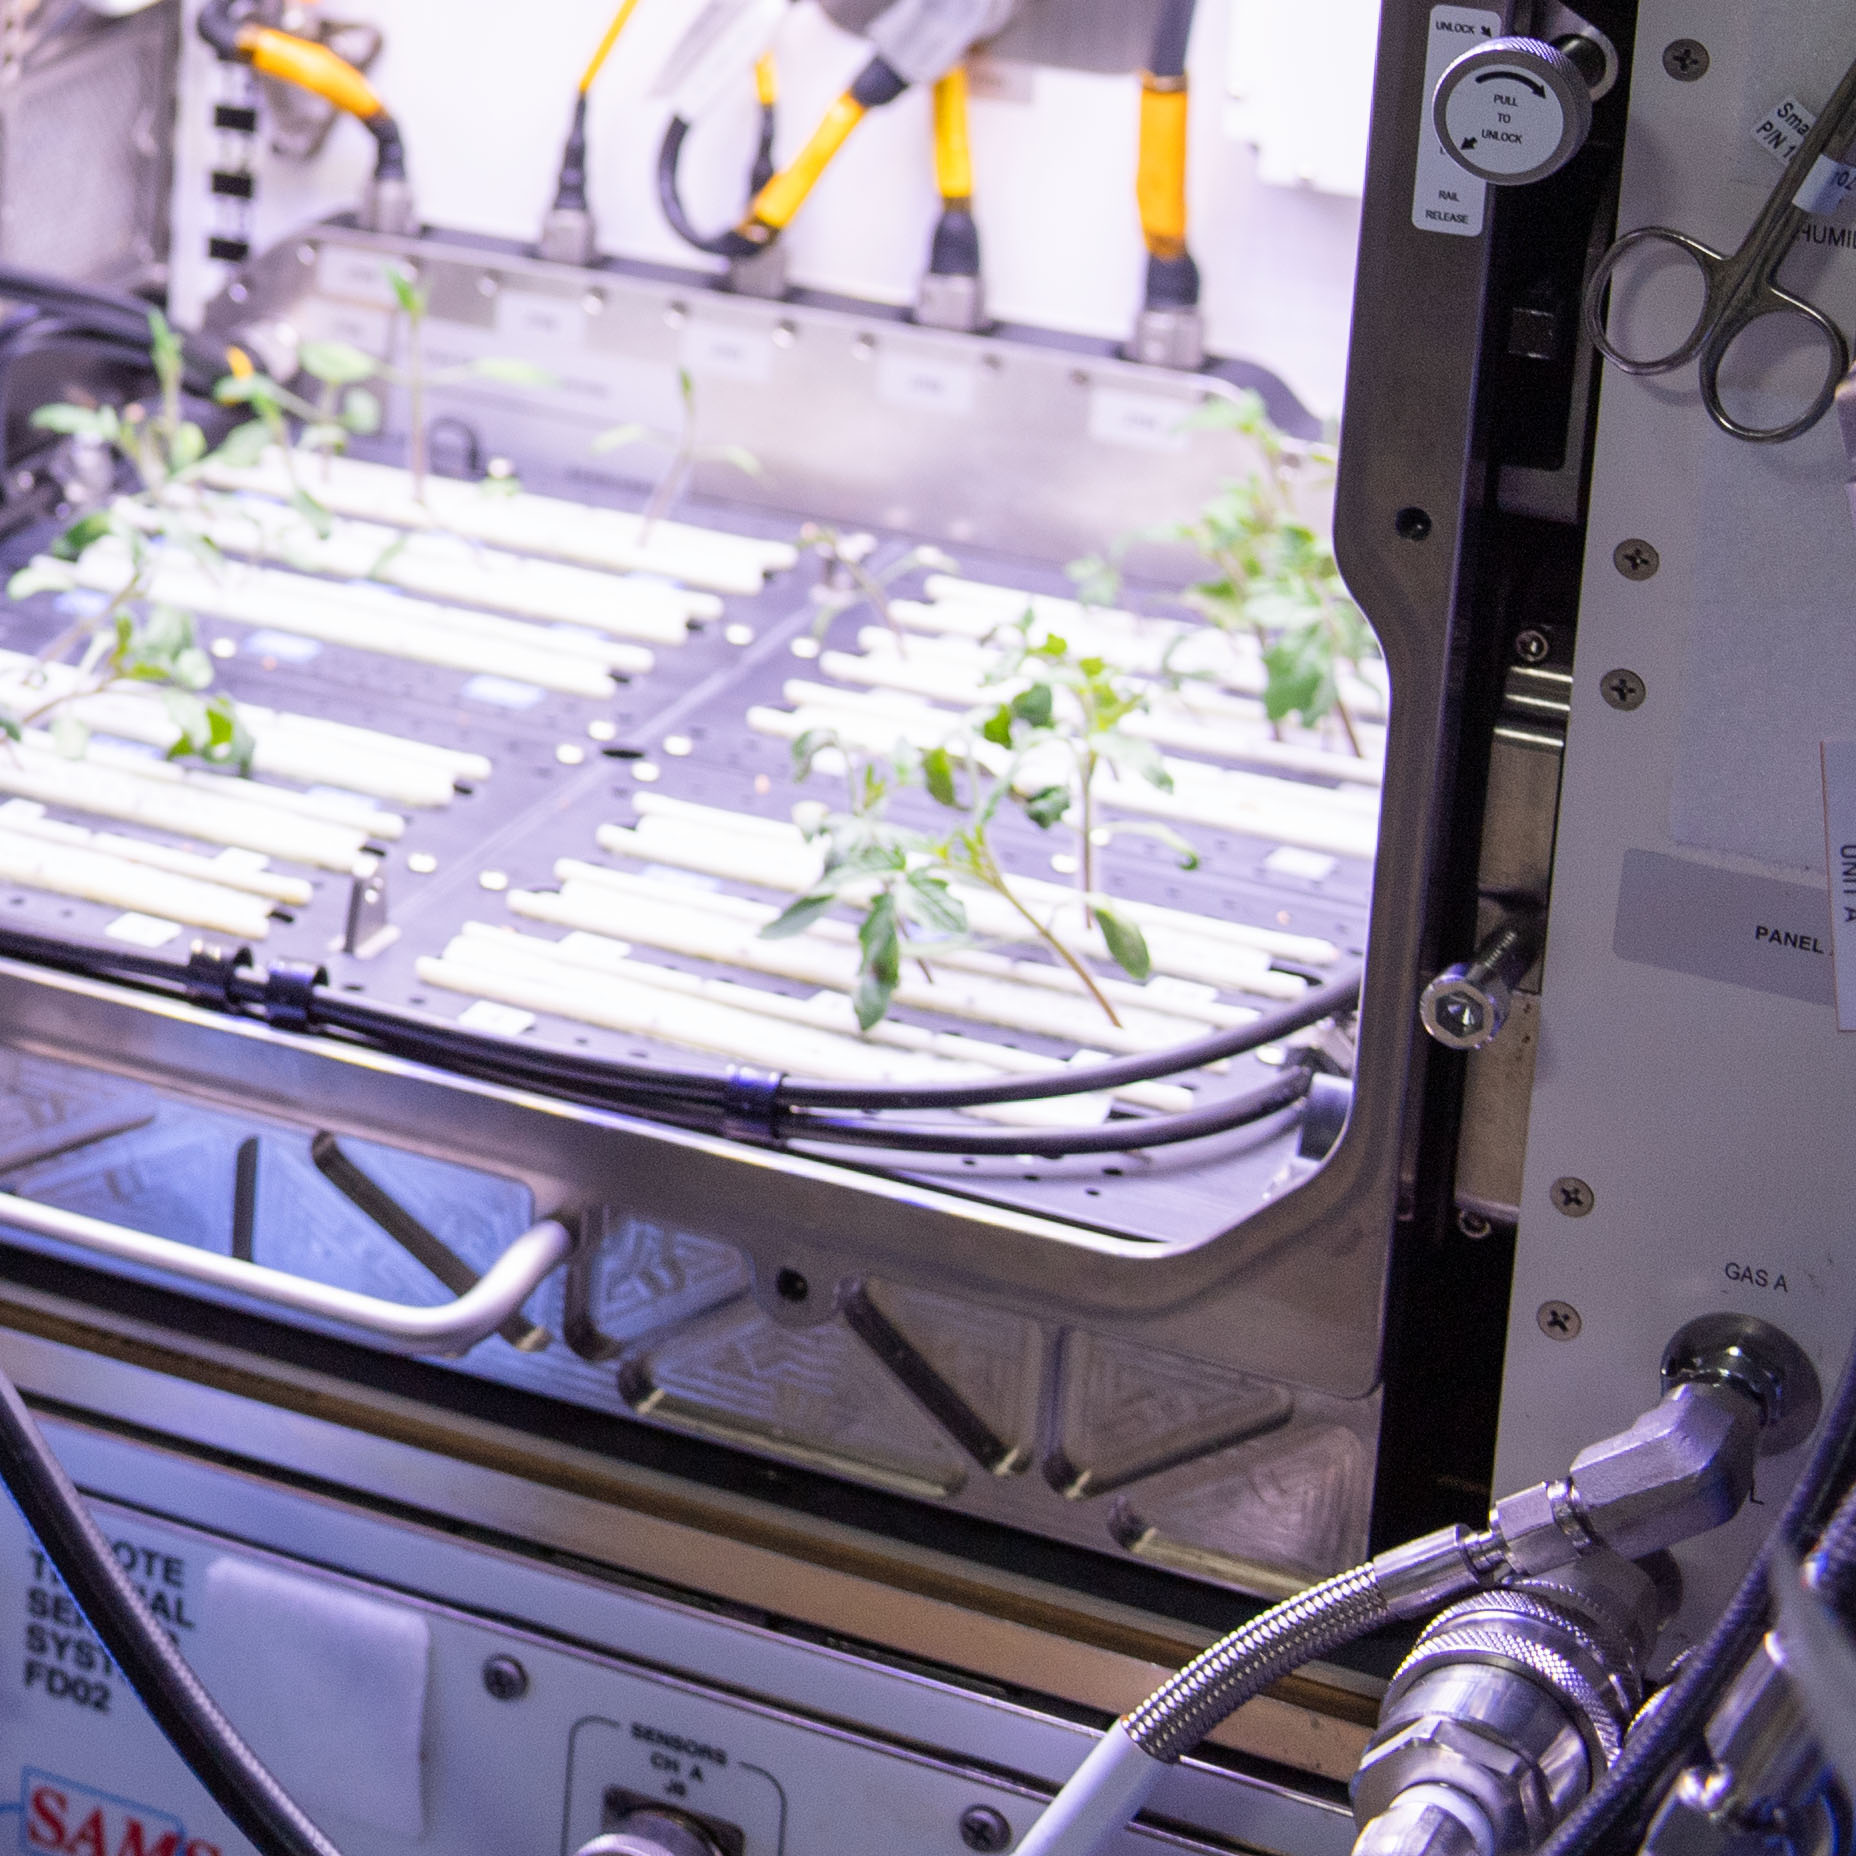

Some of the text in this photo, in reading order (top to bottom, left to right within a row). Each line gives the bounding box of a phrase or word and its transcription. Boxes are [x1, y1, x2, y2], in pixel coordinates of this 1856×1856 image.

[1436, 20, 1476, 35] UNLOCK
[1493, 94, 1519, 107] PULL
[1498, 112, 1511, 124] TO
[1777, 102, 1810, 136] Sma
[1481, 129, 1523, 145] UNLOCK
[1756, 120, 1788, 150] P/N
[1438, 189, 1460, 203] RAIL
[1425, 209, 1469, 225] RELEASE
[1801, 223, 1856, 249] HUMI
[1755, 924, 1825, 955] PANEL
[1724, 1261, 1789, 1293] GAS A
[23, 1658, 112, 1717] FD02
[631, 1722, 728, 1766] SENSORS
[649, 1750, 704, 1785] CH A
